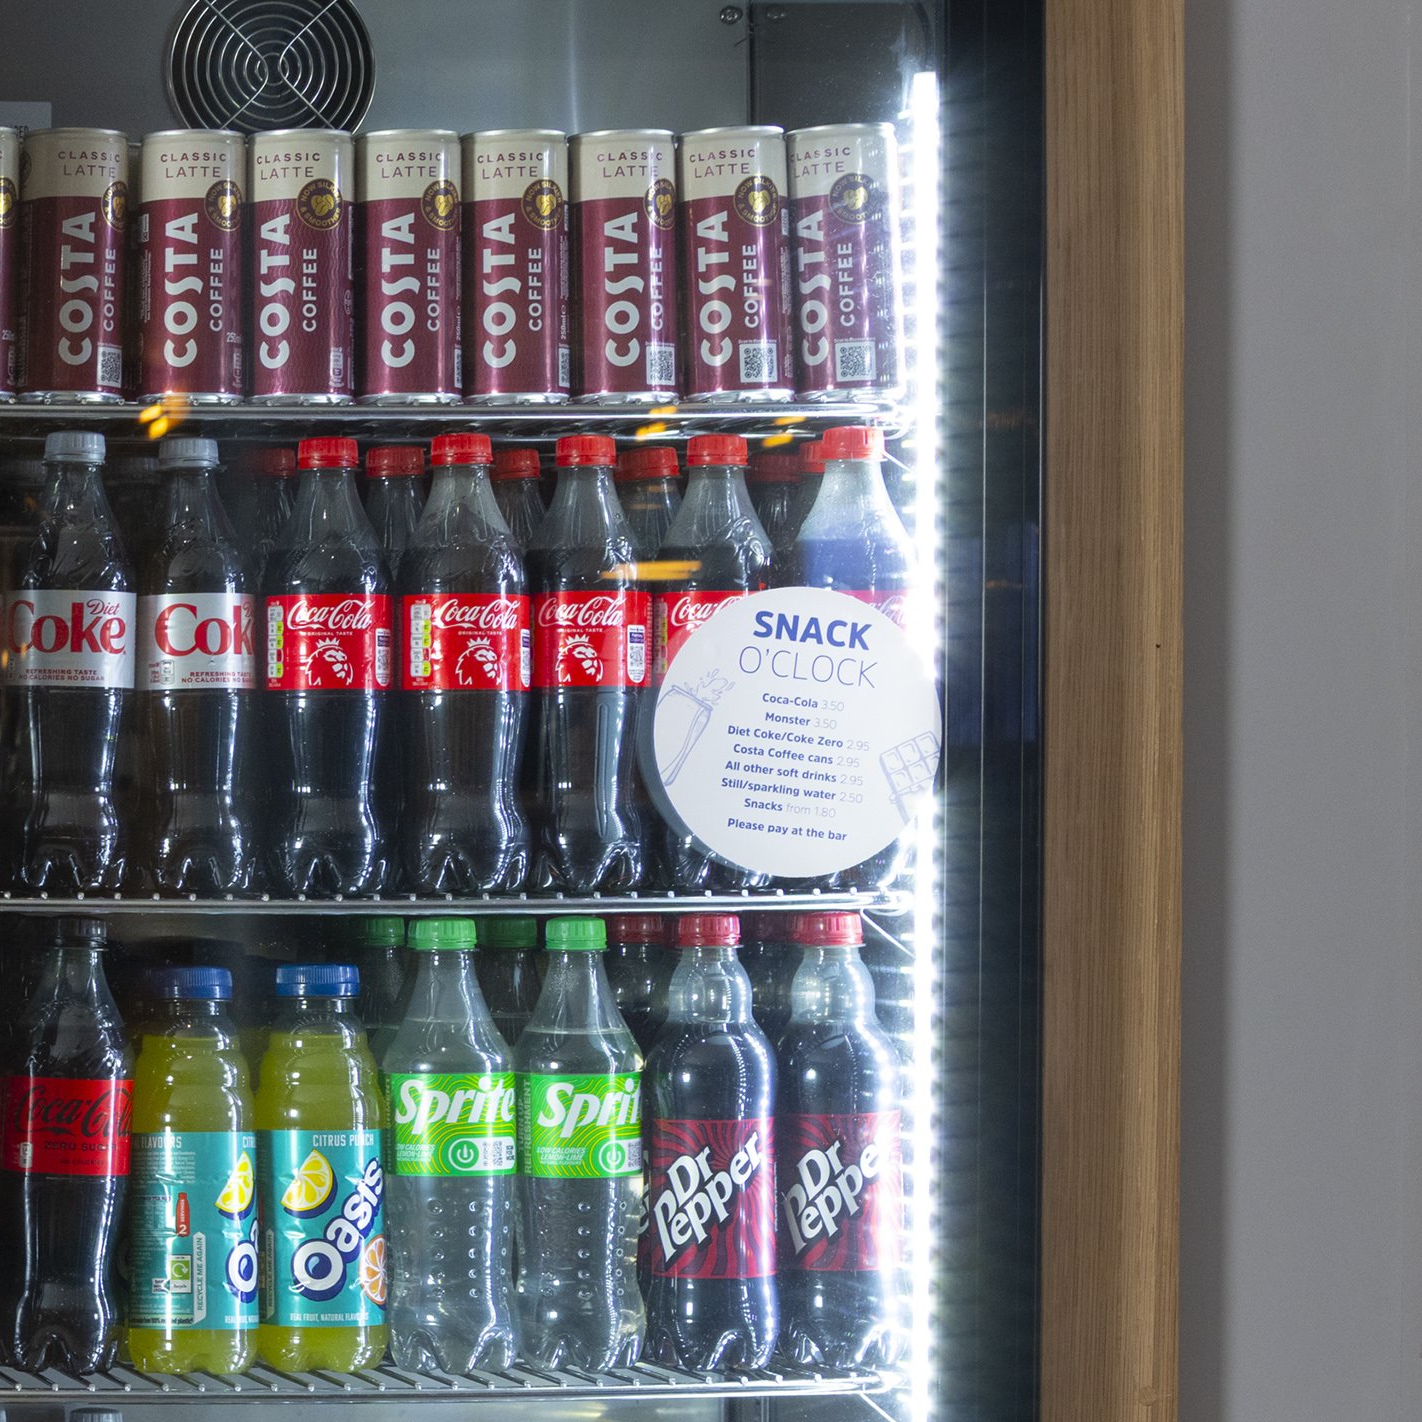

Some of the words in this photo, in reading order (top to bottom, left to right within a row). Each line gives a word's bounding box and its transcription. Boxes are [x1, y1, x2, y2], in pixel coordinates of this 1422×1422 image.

[160, 152, 228, 164] CLASSIC
[688, 148, 756, 163] CLASSIC
[693, 163, 751, 179] LATTE
[165, 165, 221, 179] LATTE
[163, 212, 204, 368] COSTA
[209, 247, 224, 332] COFFEE
[259, 213, 296, 369] COSTA
[380, 212, 421, 368] COSTA
[426, 247, 441, 332] COFFEE
[482, 212, 522, 369] COSTA
[604, 212, 645, 368] COSTA
[697, 211, 737, 367] COSTA
[741, 244, 758, 329] COFFEE
[87, 599, 121, 615] Diet
[287, 600, 375, 630] Coca-Cola
[438, 599, 521, 630] Coca-Cola
[538, 597, 626, 628] Coca-Cola
[8, 600, 126, 654] Coke
[753, 610, 872, 651] SNACK
[739, 645, 878, 689] O'CLOCK
[762, 693, 818, 708] Coca-Cola
[821, 699, 845, 712] 3.50
[765, 712, 811, 727] Monster
[814, 717, 837, 729] 3.50
[727, 725, 750, 737] Diet
[753, 728, 814, 745] Coke/Coke
[818, 736, 843, 748] Zero
[847, 740, 869, 751] 2.95
[733, 744, 765, 757] Costa
[768, 747, 805, 761] Coffee
[808, 754, 833, 765] cans
[836, 756, 860, 768] 2.95
[725, 760, 740, 771] All
[743, 763, 773, 775] other
[777, 766, 799, 778] soft
[802, 770, 837, 783] drinks
[840, 774, 863, 786] 2.95
[721, 778, 800, 797] Still/sparkling
[803, 788, 836, 800] water
[839, 792, 863, 804] 2.50
[744, 798, 782, 811] Snacks
[786, 802, 811, 814] from
[814, 806, 836, 818] 1.80
[727, 818, 764, 831] Please
[768, 822, 788, 835] pay
[791, 827, 804, 836] at
[806, 827, 824, 838] the
[828, 829, 847, 841] bar
[395, 1076, 515, 1135] Sprite
[313, 1135, 346, 1147] CITRUS
[668, 1145, 716, 1198] Dr
[654, 1131, 764, 1264] Pepper
[294, 1160, 384, 1291] Oasis
